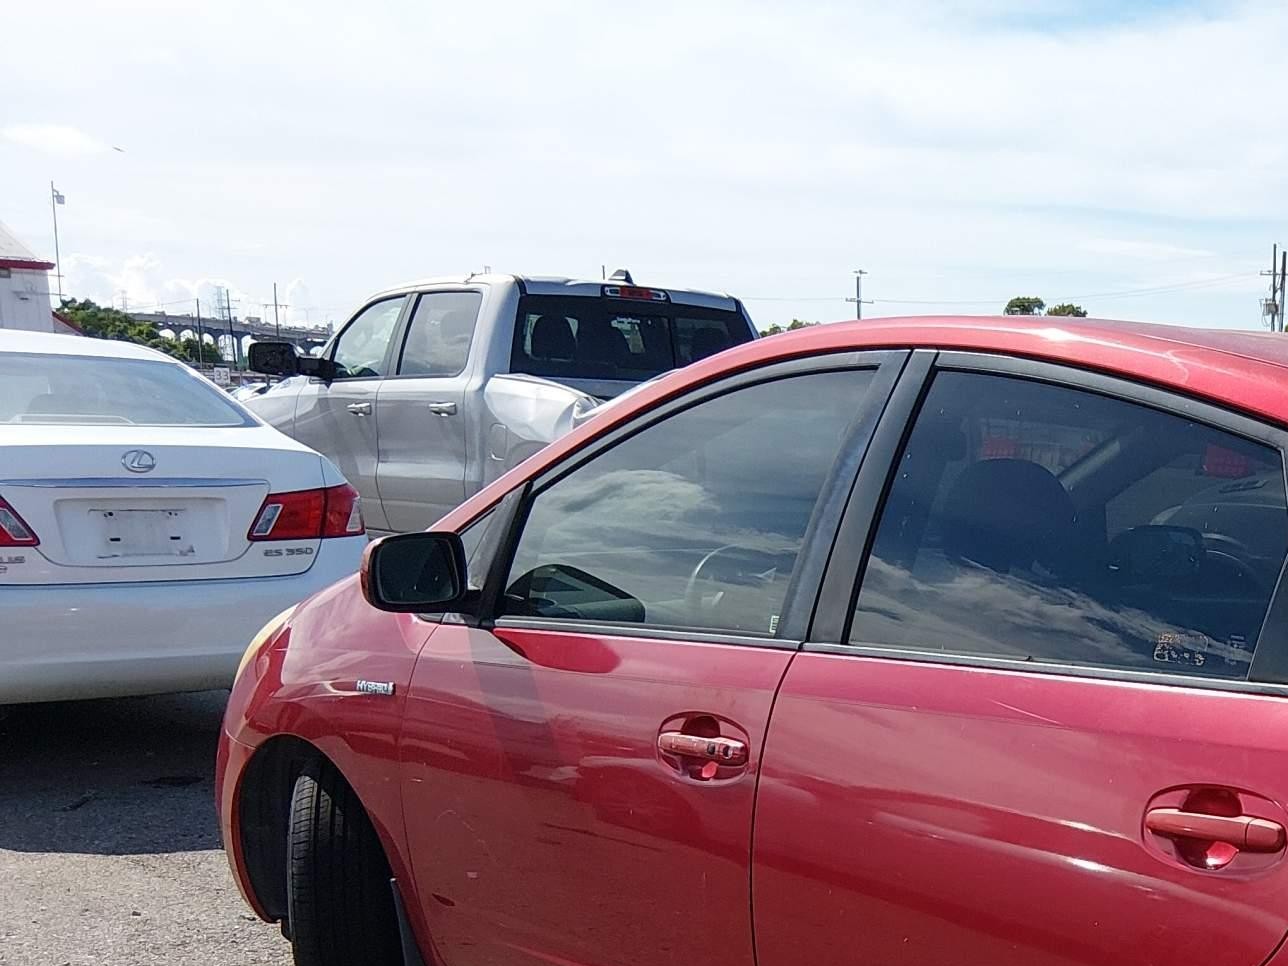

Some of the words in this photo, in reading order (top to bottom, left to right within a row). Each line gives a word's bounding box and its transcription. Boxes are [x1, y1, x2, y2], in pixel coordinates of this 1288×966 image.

[214, 370, 230, 381] 33
[263, 548, 284, 557] ES
[285, 546, 315, 556] 350
